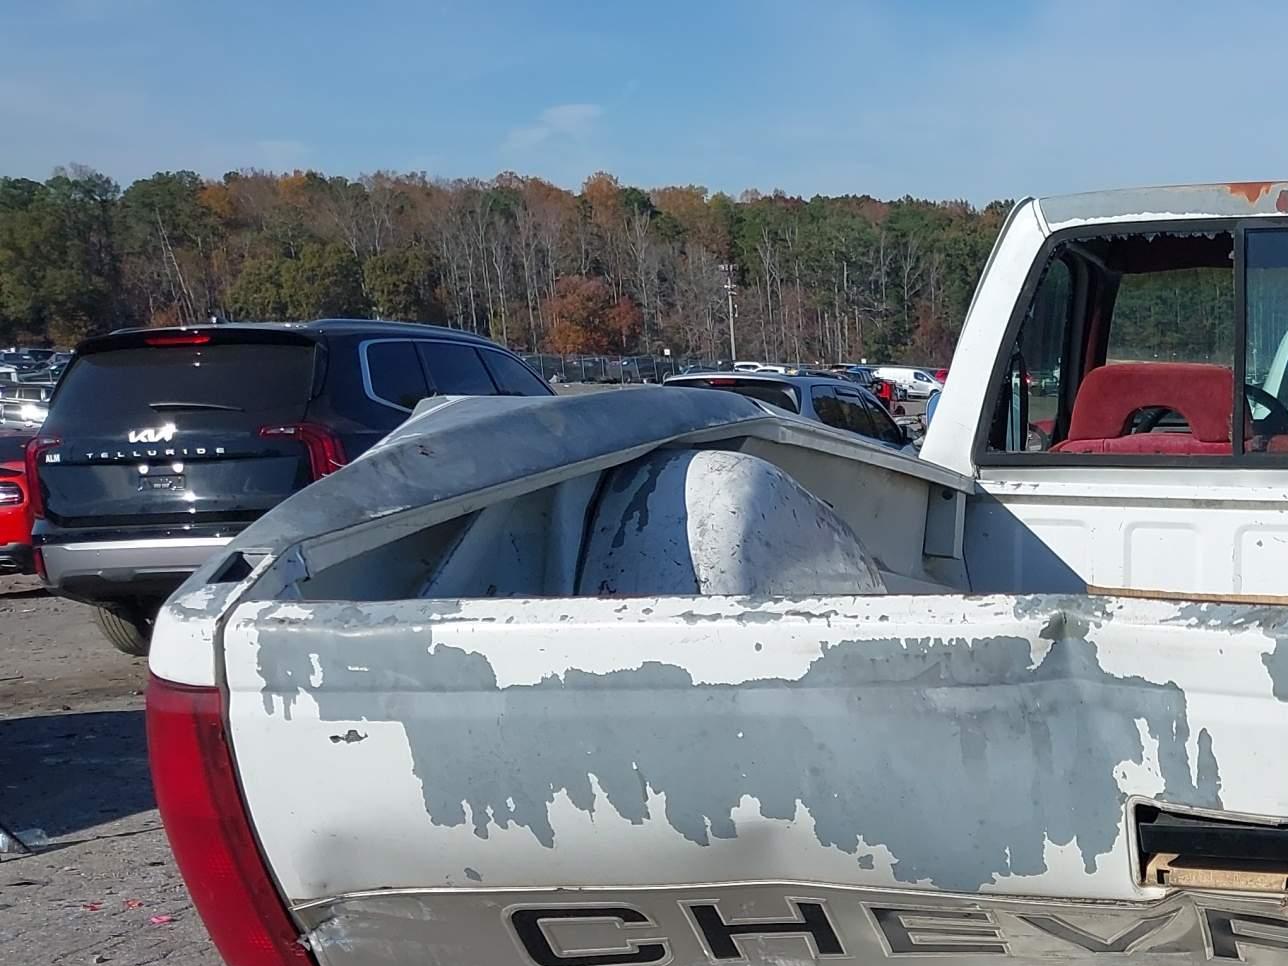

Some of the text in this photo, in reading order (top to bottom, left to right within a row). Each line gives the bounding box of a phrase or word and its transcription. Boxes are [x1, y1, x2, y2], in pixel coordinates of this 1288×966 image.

[128, 423, 176, 443] KIA
[45, 454, 61, 464] ALM
[86, 447, 225, 459] TELLURIDE
